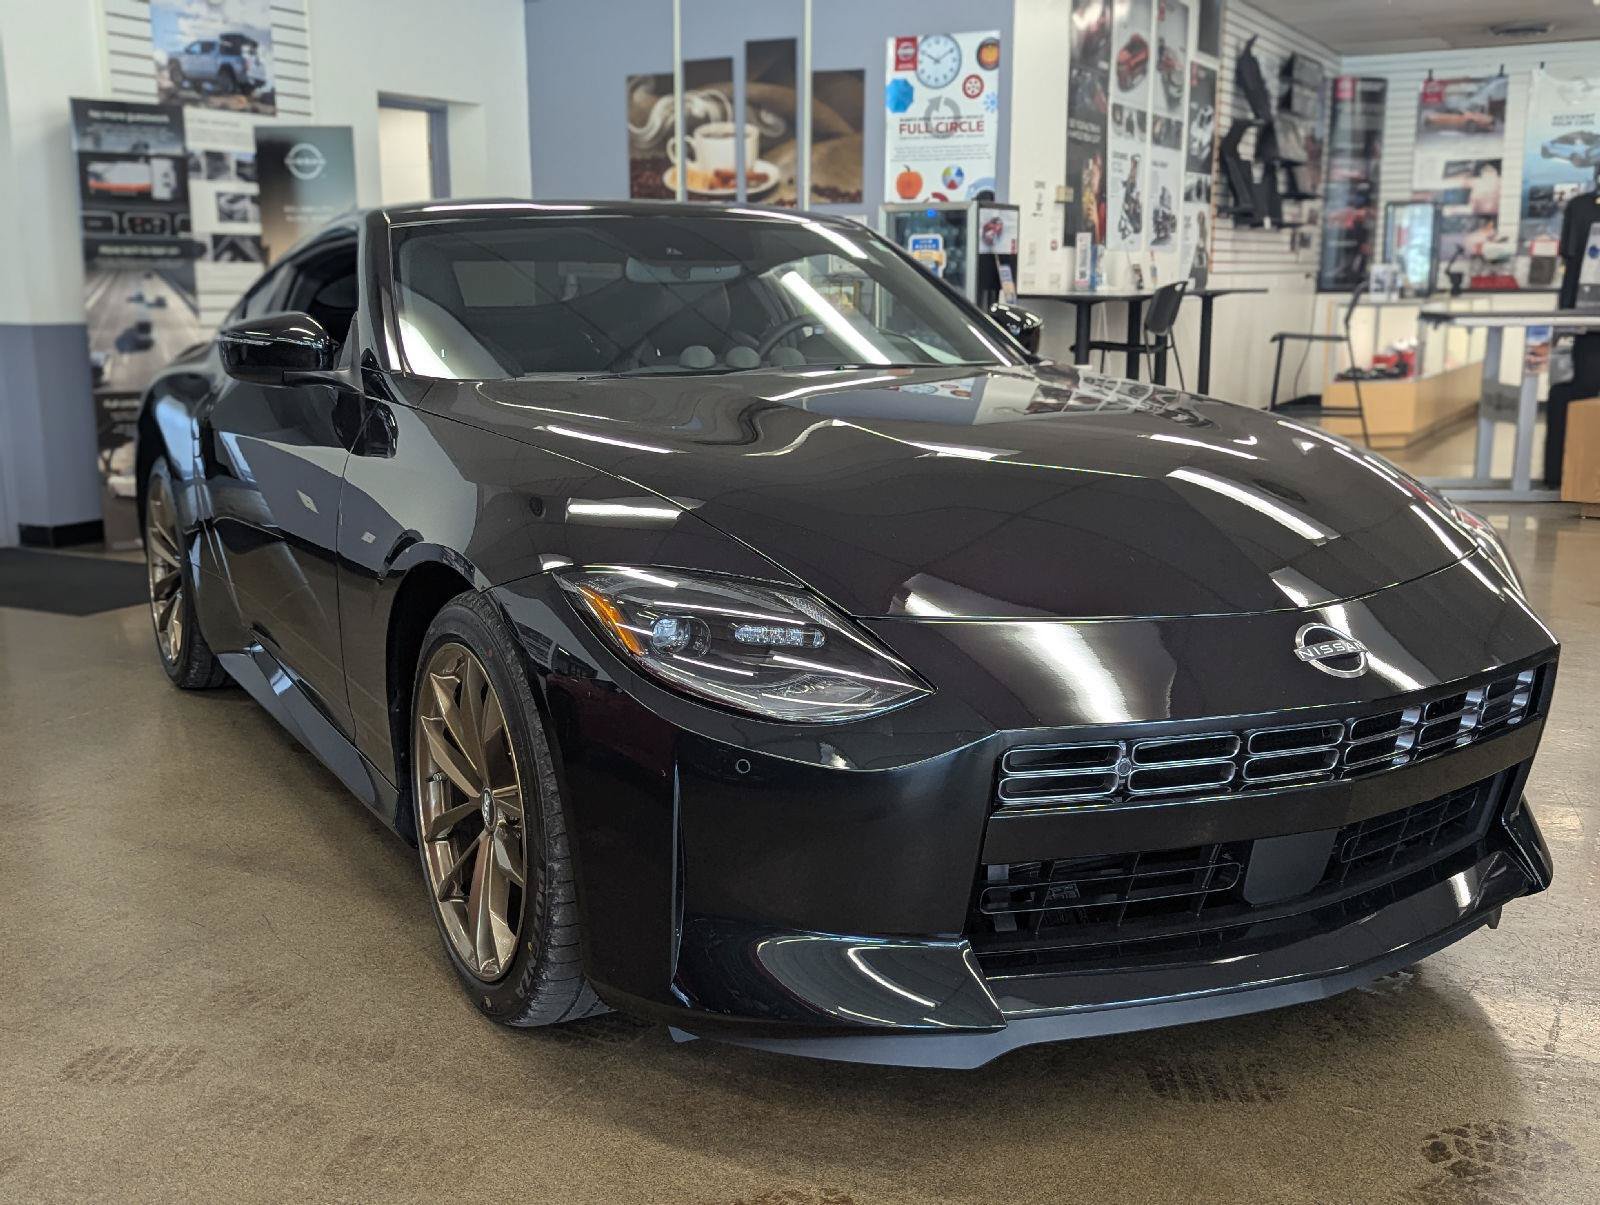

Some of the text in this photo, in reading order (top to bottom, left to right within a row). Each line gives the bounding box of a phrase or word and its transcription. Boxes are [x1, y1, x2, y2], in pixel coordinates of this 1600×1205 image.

[898, 120, 985, 135] FULL CIRCLE
[1299, 641, 1363, 659] NISSAN
